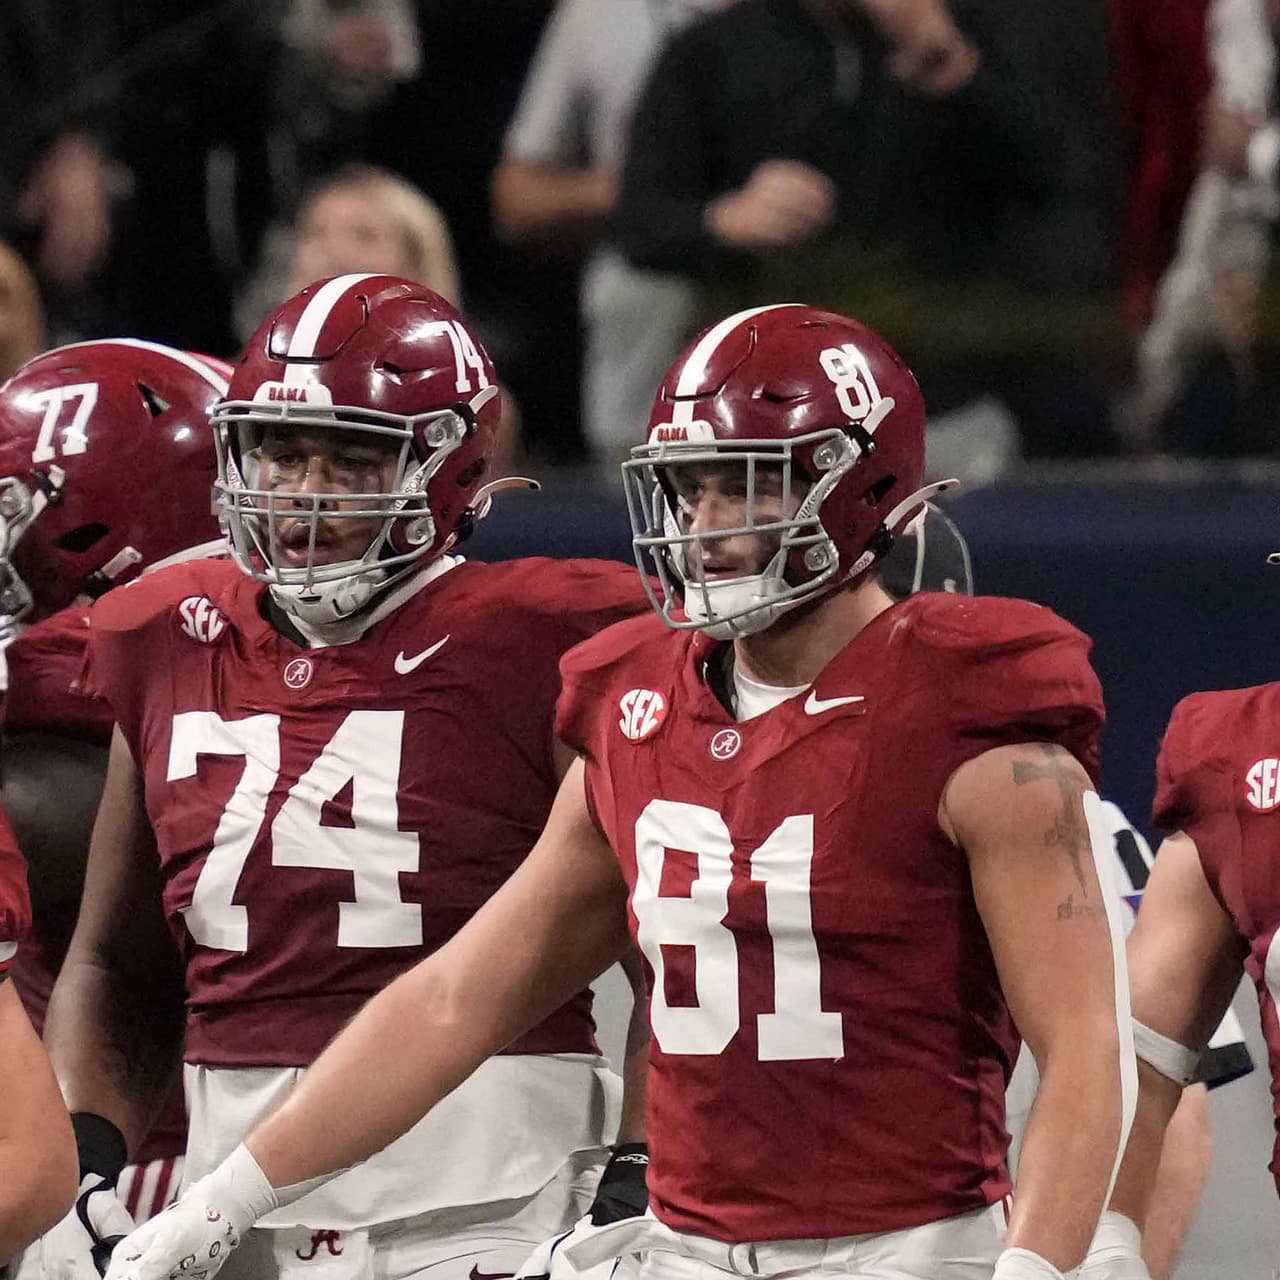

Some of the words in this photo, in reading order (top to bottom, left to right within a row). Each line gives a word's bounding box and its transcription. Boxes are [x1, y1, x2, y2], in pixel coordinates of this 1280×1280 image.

[402, 320, 490, 393] 74
[819, 344, 883, 419] 81
[14, 382, 99, 463] 77
[269, 387, 308, 402] BAMA
[179, 597, 224, 642] SEC
[619, 688, 664, 740] SEC
[1246, 758, 1280, 809] SE
[165, 710, 424, 952] 74
[632, 798, 844, 1062] 81
